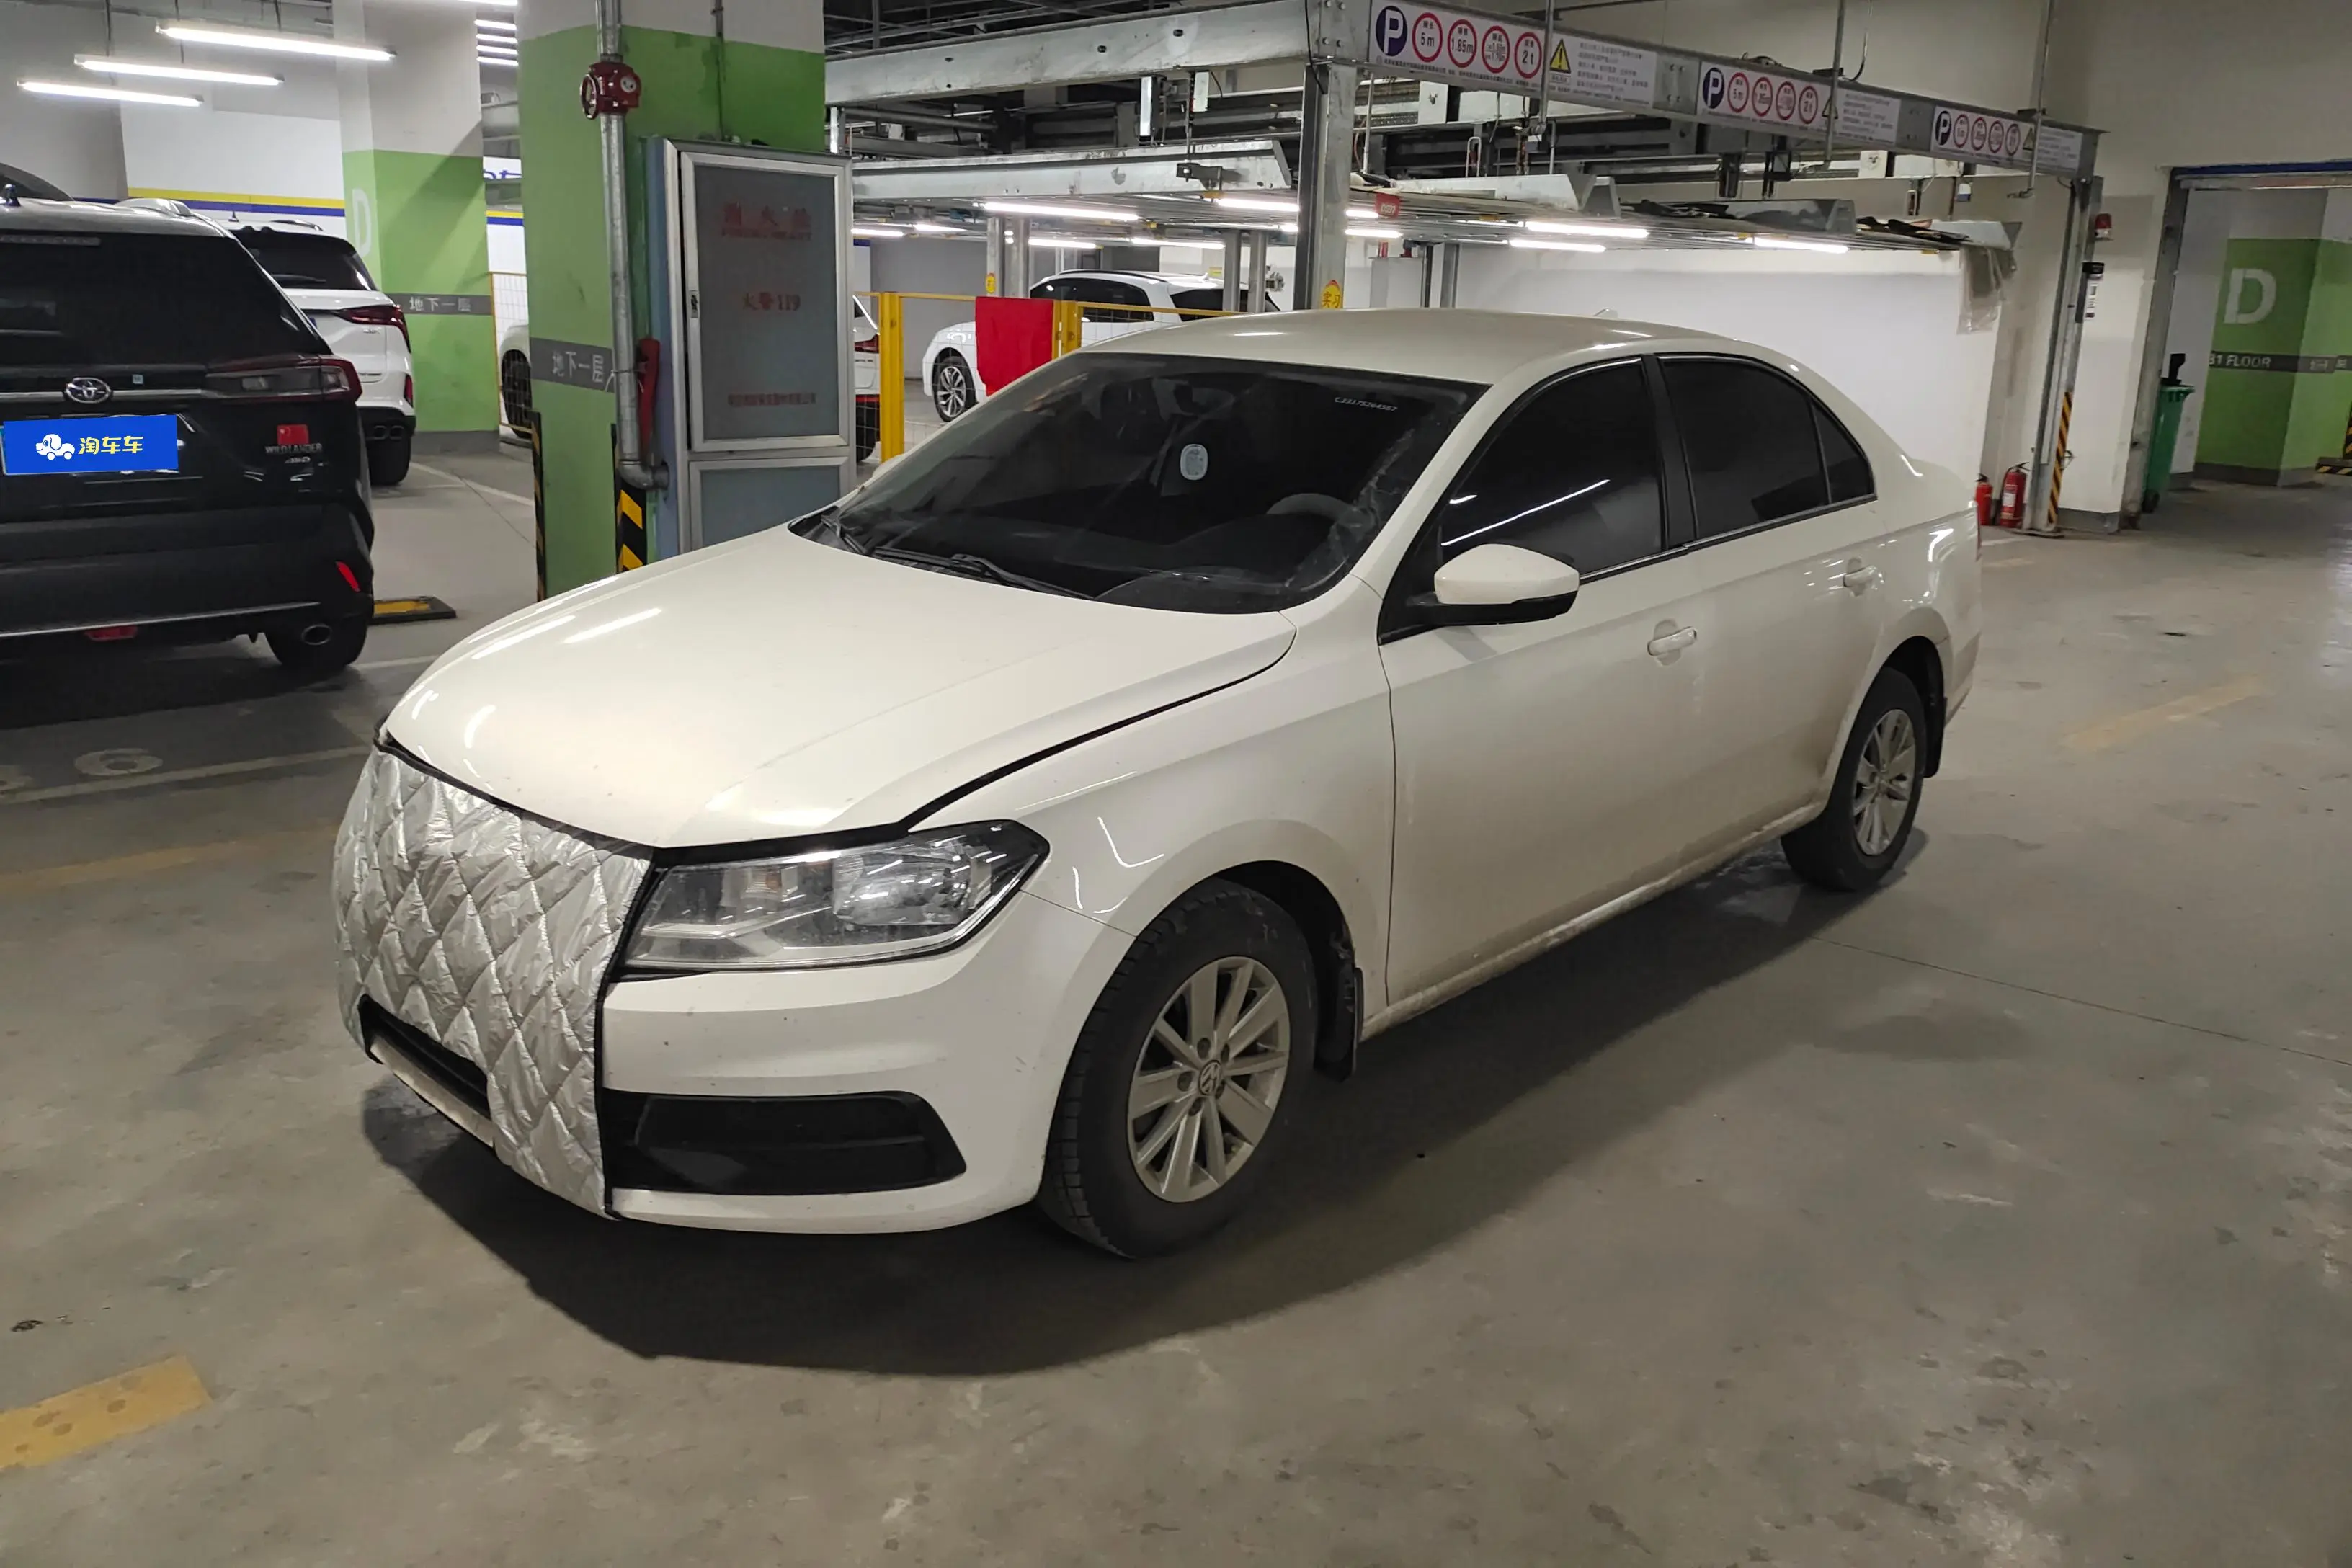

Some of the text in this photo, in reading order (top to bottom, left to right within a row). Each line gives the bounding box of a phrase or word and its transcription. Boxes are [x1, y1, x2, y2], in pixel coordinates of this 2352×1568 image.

[1384, 9, 1404, 55] P
[1707, 71, 1723, 107] P
[1937, 112, 1951, 142] P
[352, 187, 371, 258] D
[409, 296, 472, 312] 地下一层
[2223, 267, 2277, 325] D
[551, 350, 604, 384] 地下一层
[2225, 355, 2272, 369] FLOOR
